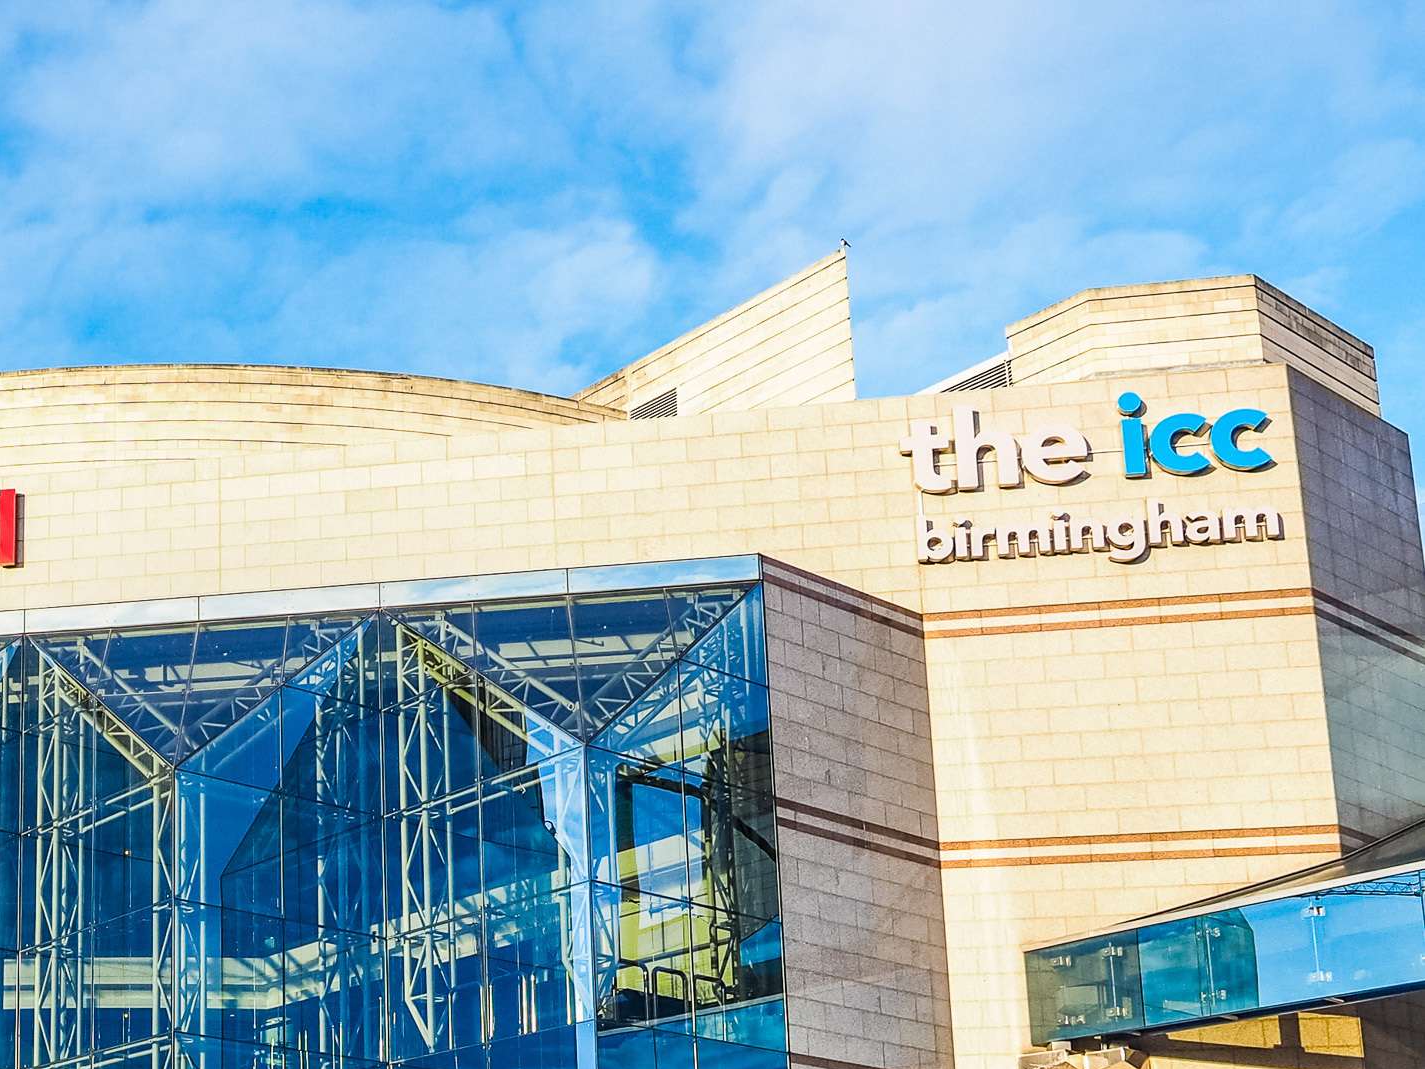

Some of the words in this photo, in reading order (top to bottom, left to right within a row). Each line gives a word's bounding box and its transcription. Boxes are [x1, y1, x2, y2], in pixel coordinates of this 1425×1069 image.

[899, 405, 1090, 495] the
[1117, 391, 1274, 479] icc
[917, 499, 1283, 565] birmingham
